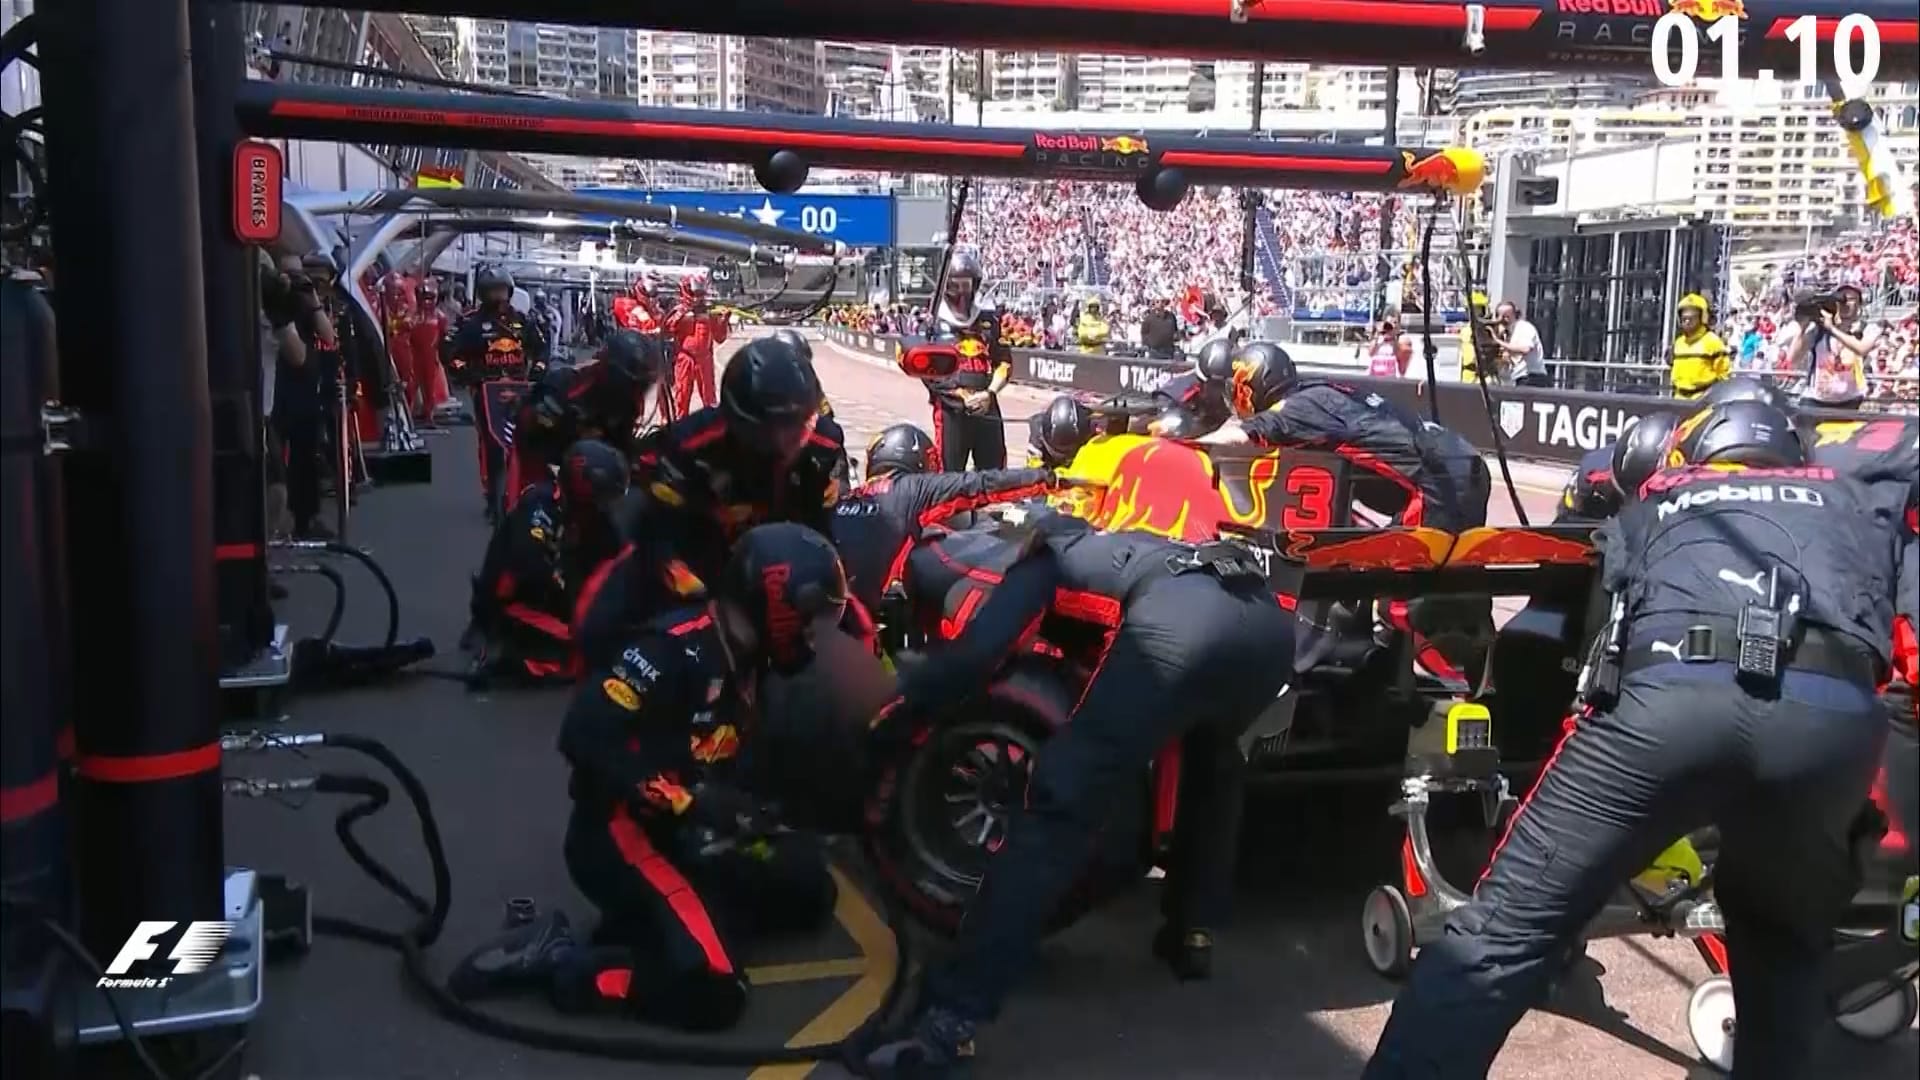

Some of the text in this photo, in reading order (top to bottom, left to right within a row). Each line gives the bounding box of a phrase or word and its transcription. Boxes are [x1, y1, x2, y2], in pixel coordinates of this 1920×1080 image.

[1033, 132, 1098, 151] Red Bull
[1036, 151, 1149, 168] RACING
[251, 157, 267, 229] BRAKES
[1532, 401, 1640, 450] TAGH
[1282, 464, 1336, 533] 3
[1657, 484, 1773, 522] Mobil
